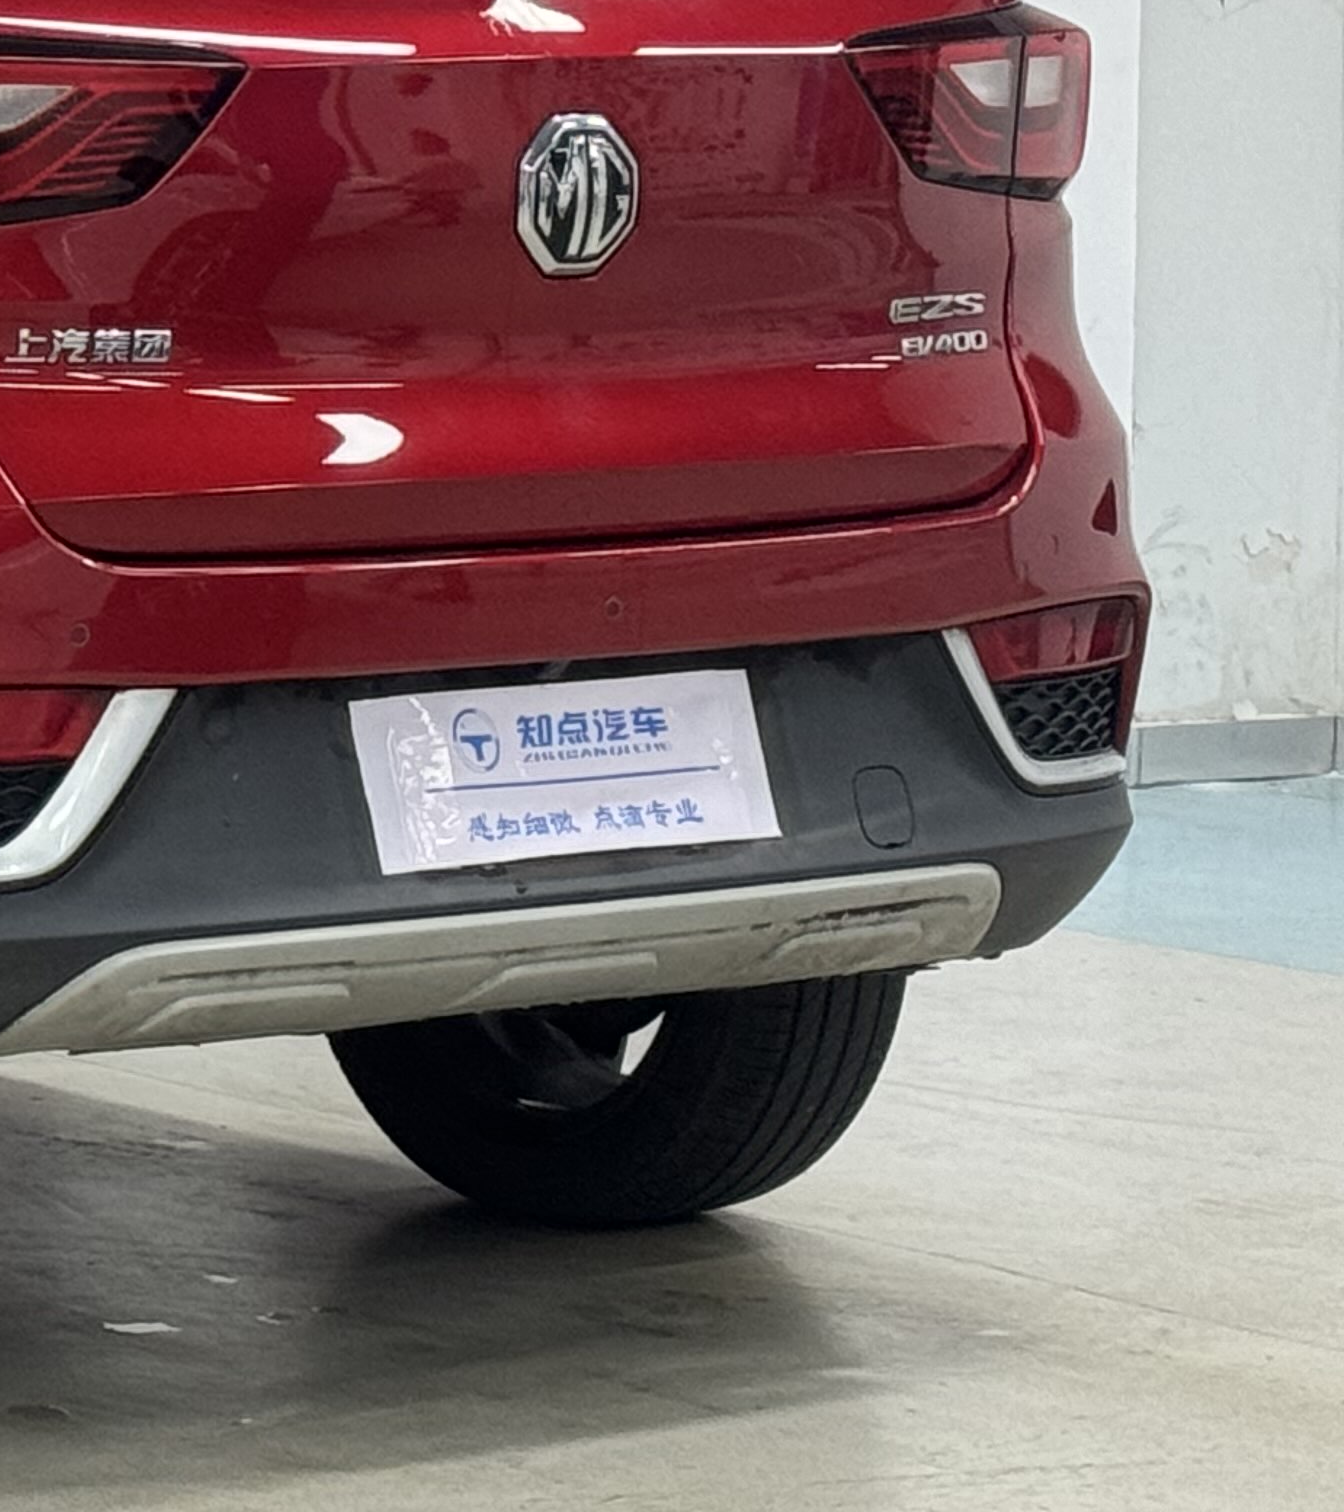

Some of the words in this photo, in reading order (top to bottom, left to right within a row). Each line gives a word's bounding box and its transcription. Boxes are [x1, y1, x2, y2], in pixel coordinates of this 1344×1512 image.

[536, 133, 631, 260] MG
[889, 292, 987, 325] EZS
[4, 327, 173, 364] 上汽集团
[901, 329, 988, 357] EV400
[516, 706, 669, 749] 知点汽车
